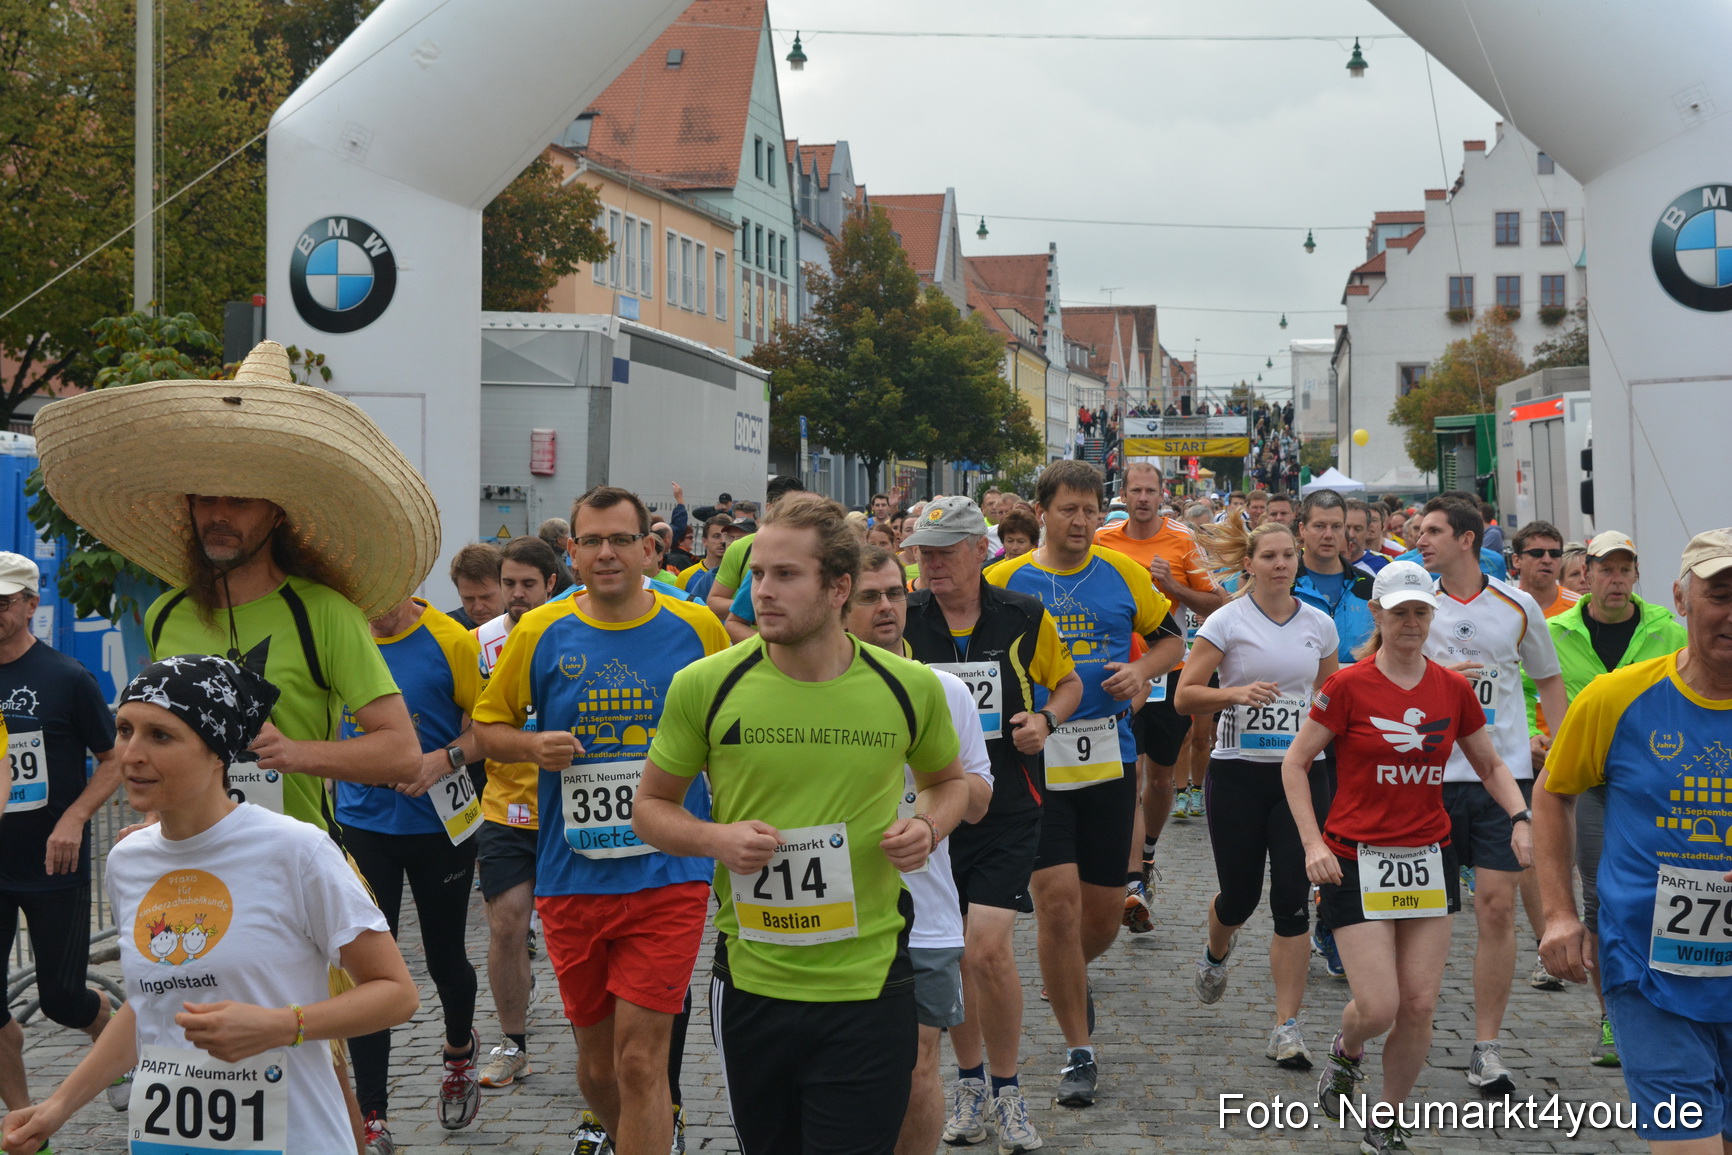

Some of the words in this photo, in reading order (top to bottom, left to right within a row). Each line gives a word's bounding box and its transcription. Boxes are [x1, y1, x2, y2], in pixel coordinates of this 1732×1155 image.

[297, 219, 388, 258] BMW
[735, 411, 763, 454] BOCK
[1164, 441, 1208, 452] START
[0, 700, 22, 712] pitz
[580, 714, 632, 723] 21.September
[1246, 707, 1300, 732] 2521
[744, 727, 805, 744] GOSSEN
[810, 728, 897, 749] METRAWATT
[1072, 724, 1106, 734] Neumarkt
[1077, 736, 1091, 762] 9
[1259, 736, 1291, 748] Sabine
[572, 750, 648, 759] ww.stadtlauf-neuma
[564, 774, 594, 785] PARTL
[597, 770, 643, 782] Neumark
[572, 785, 639, 823] 338
[579, 826, 645, 850] Diete
[773, 839, 825, 853] eumarkt
[1389, 849, 1427, 860] Neumarkt
[753, 856, 828, 901] 214
[1378, 858, 1430, 888] 205
[1661, 875, 1702, 891] PARTL
[1706, 882, 1732, 894] Neu
[1392, 895, 1419, 909] Patty
[762, 911, 821, 929] Bastian
[140, 973, 218, 995] Ingolstadt
[140, 1059, 182, 1077] PARTL
[184, 1064, 258, 1082] Neumarkt
[145, 1082, 264, 1142] 2091
